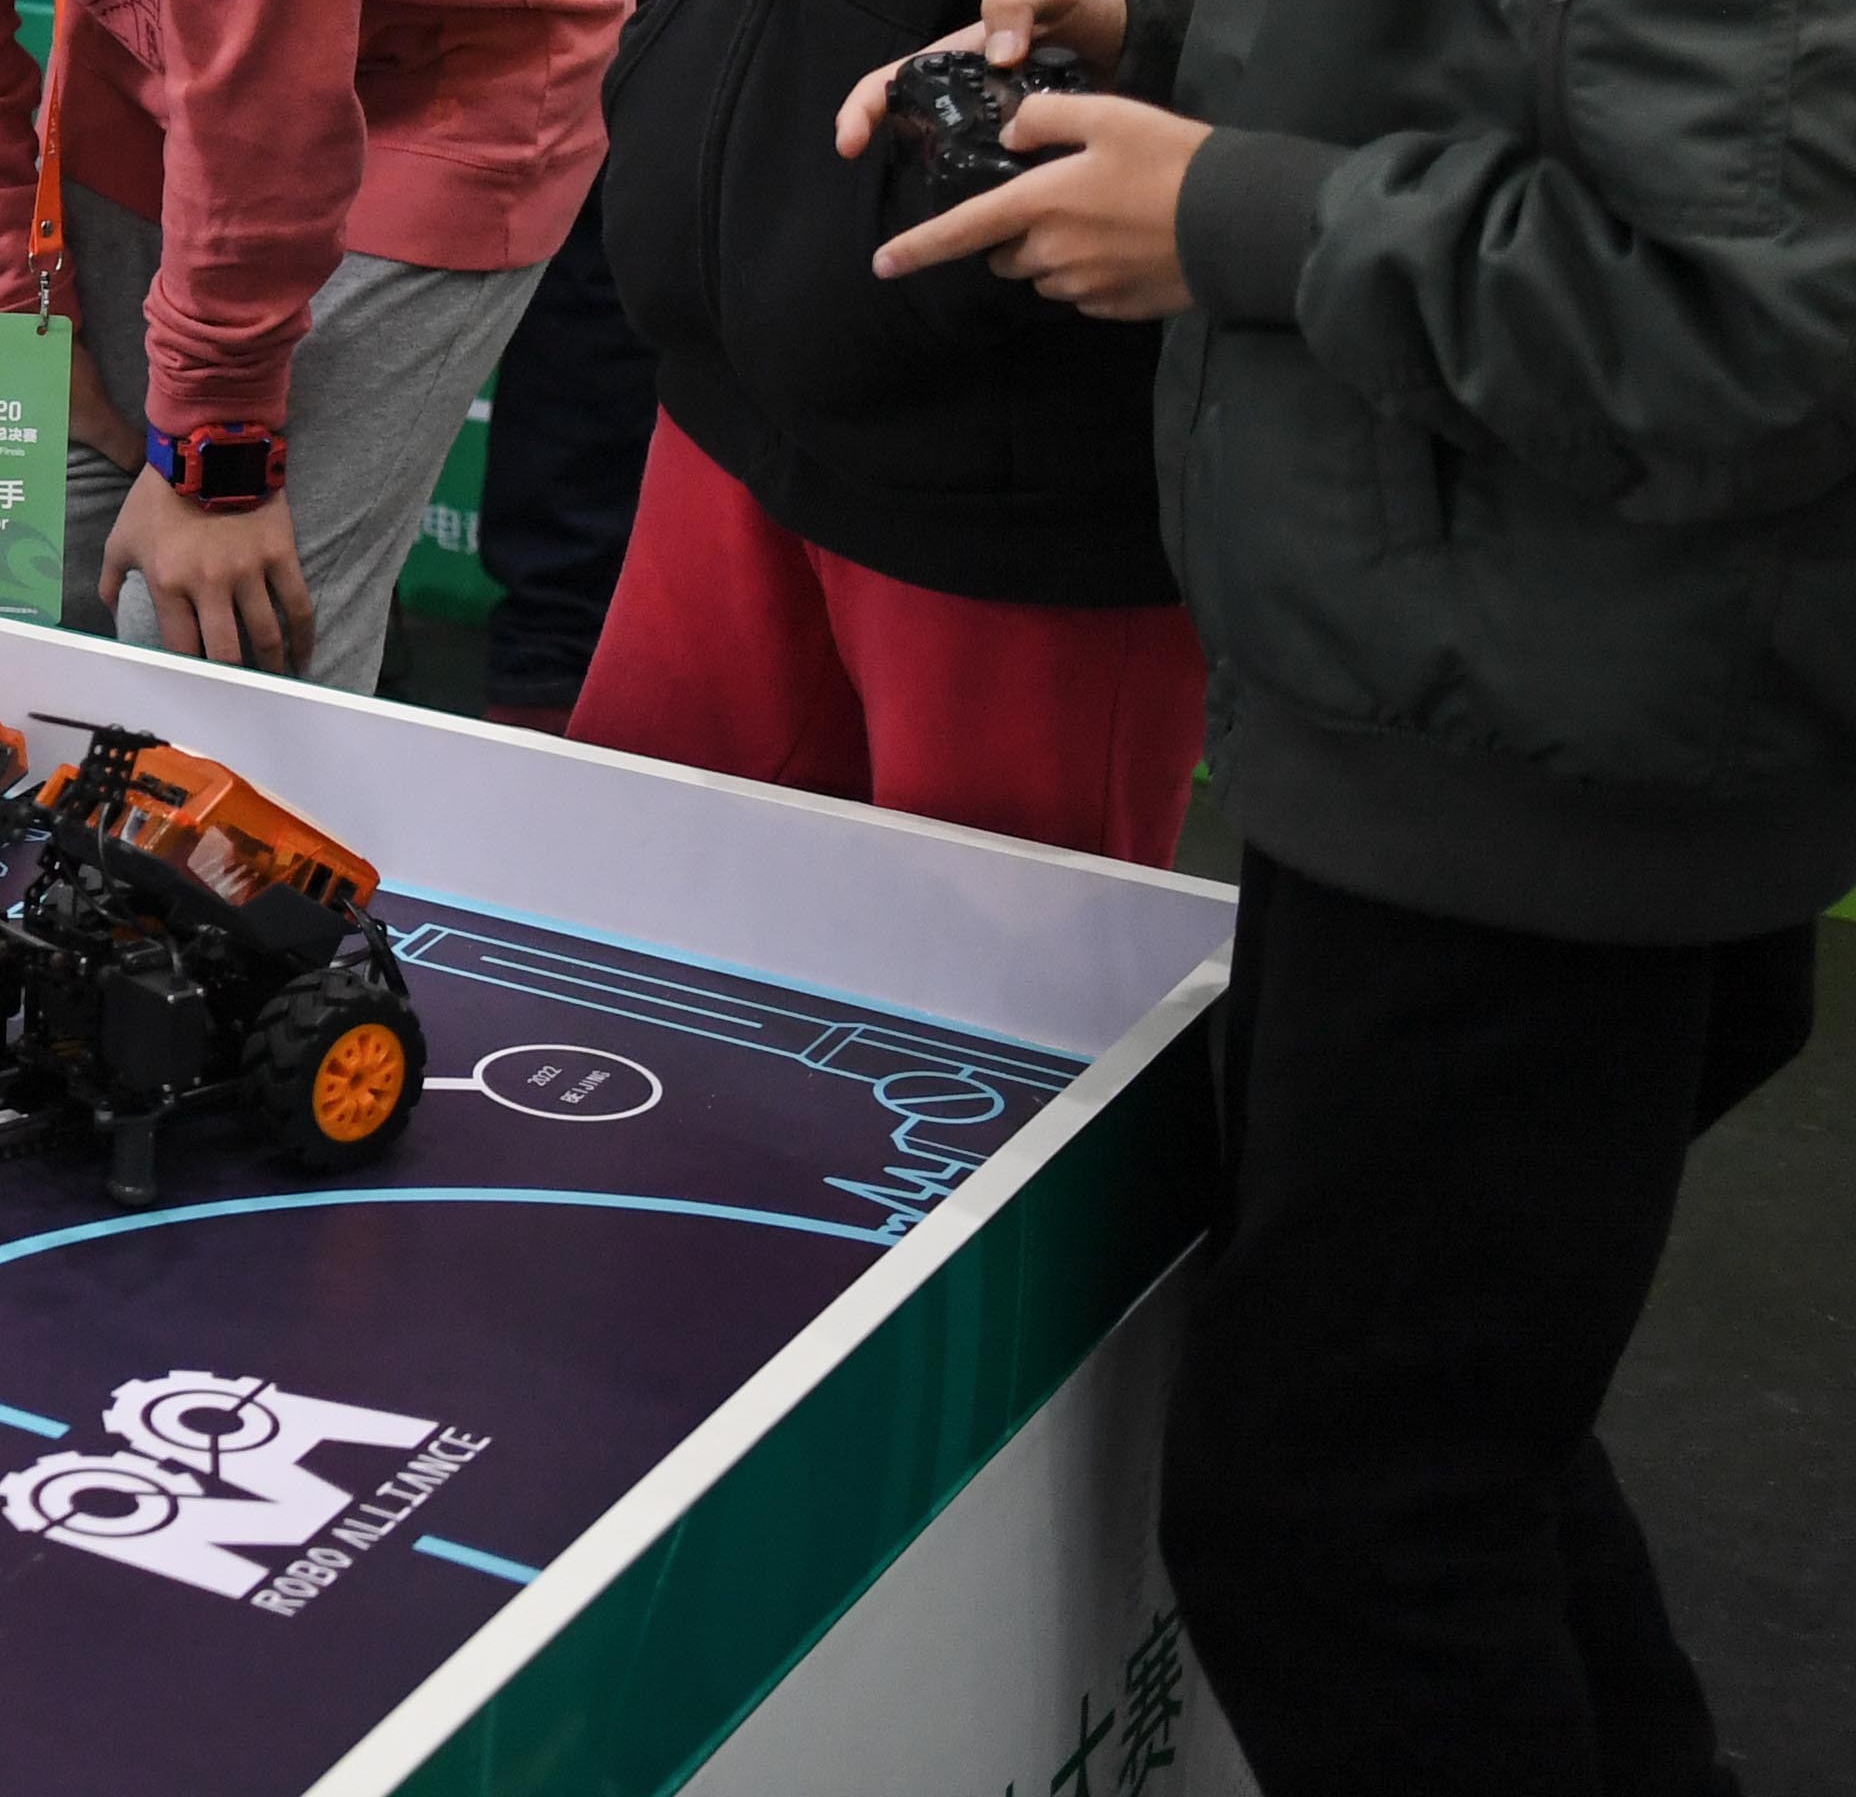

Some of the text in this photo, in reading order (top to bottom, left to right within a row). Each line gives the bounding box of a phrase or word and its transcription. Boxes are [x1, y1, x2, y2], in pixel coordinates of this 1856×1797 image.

[526, 1065, 563, 1087] 2022
[559, 1069, 612, 1104] BEIJING
[250, 1424, 493, 1618] ROBO ALLIANCE
